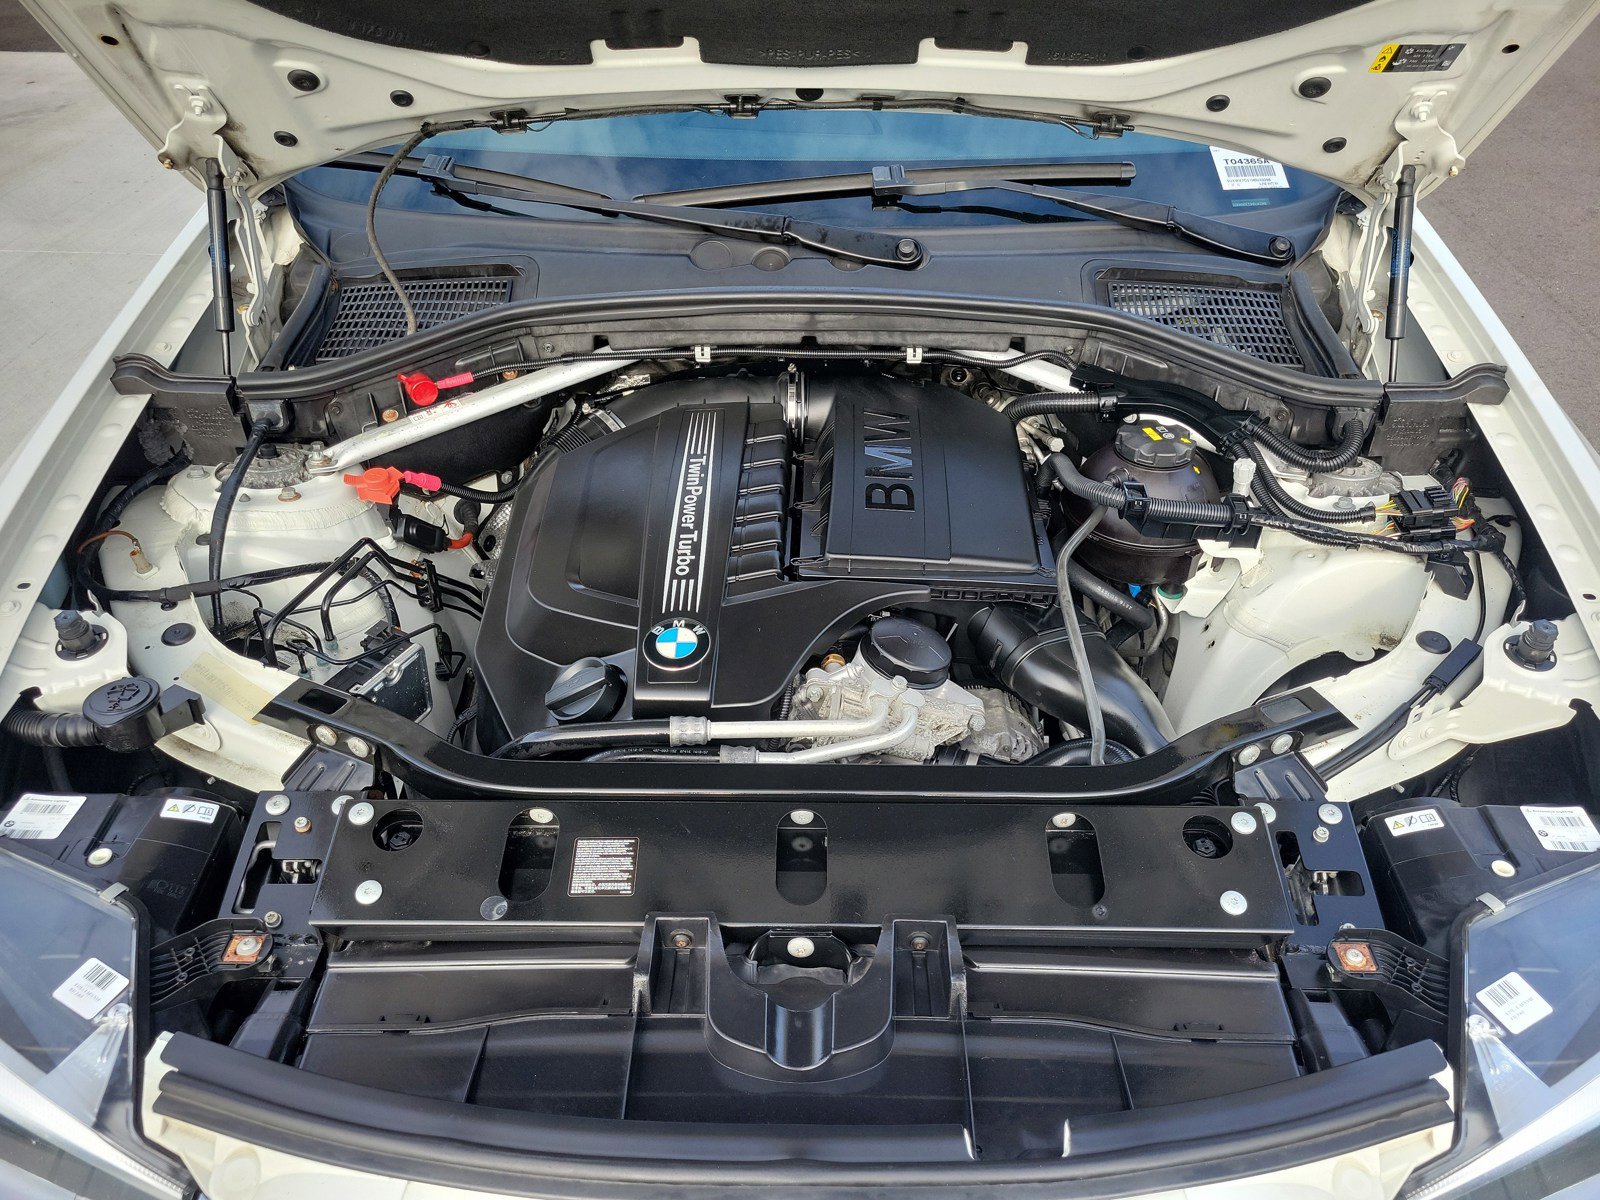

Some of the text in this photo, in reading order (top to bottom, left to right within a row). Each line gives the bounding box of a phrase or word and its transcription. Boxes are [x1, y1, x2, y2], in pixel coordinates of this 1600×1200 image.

[1223, 157, 1270, 165] T04365A
[863, 407, 915, 512] BMW
[675, 455, 706, 576] TwinPower Turbo
[651, 619, 706, 636] BMW
